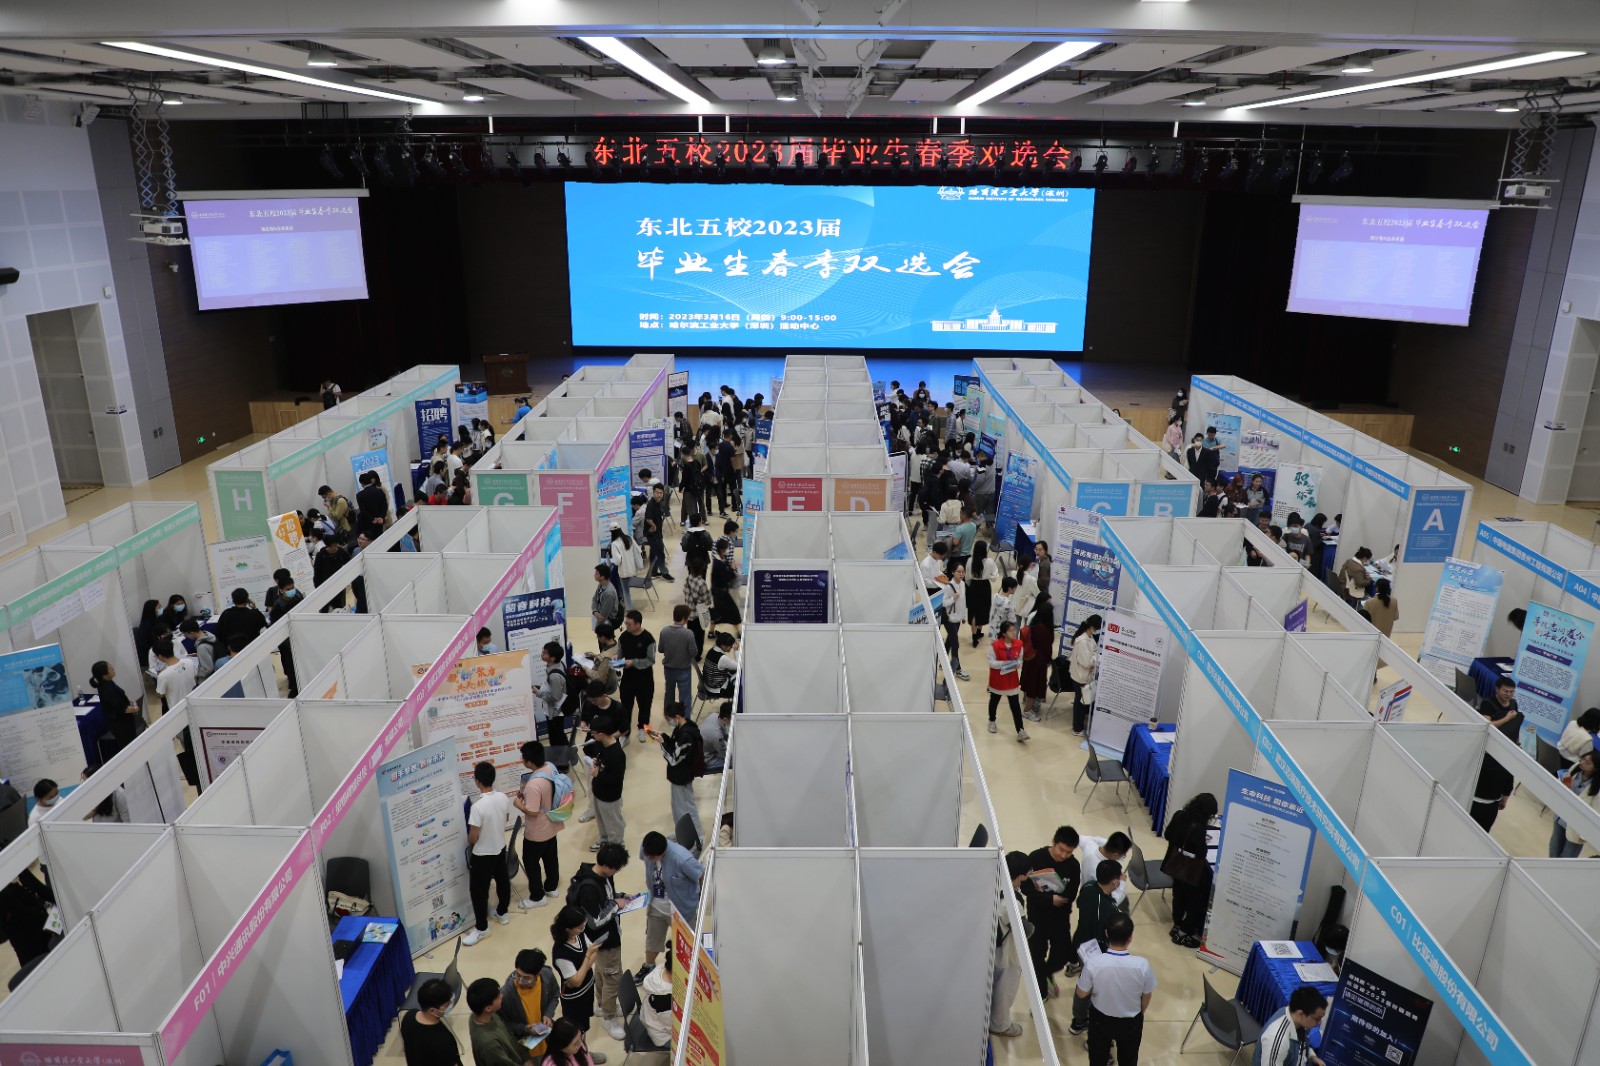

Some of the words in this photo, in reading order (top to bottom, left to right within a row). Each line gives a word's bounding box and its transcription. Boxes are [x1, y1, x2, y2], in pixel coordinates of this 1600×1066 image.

[593, 136, 1071, 169] 东北五校2023届毕业生春季双选会
[636, 217, 842, 237] 东北五校2023届
[636, 247, 981, 282] 毕业生春季双选会
[420, 407, 448, 422] 招聘
[231, 488, 253, 511] H
[557, 492, 574, 515] F
[1422, 508, 1445, 531] A
[1573, 582, 1588, 595] A04
[319, 814, 332, 835] F02
[193, 981, 212, 1012] F01
[217, 866, 293, 978] 中兴通讯股份有限公司
[1390, 905, 1407, 931] C01
[1411, 930, 1499, 1052] 比亚迪股份有限公司
